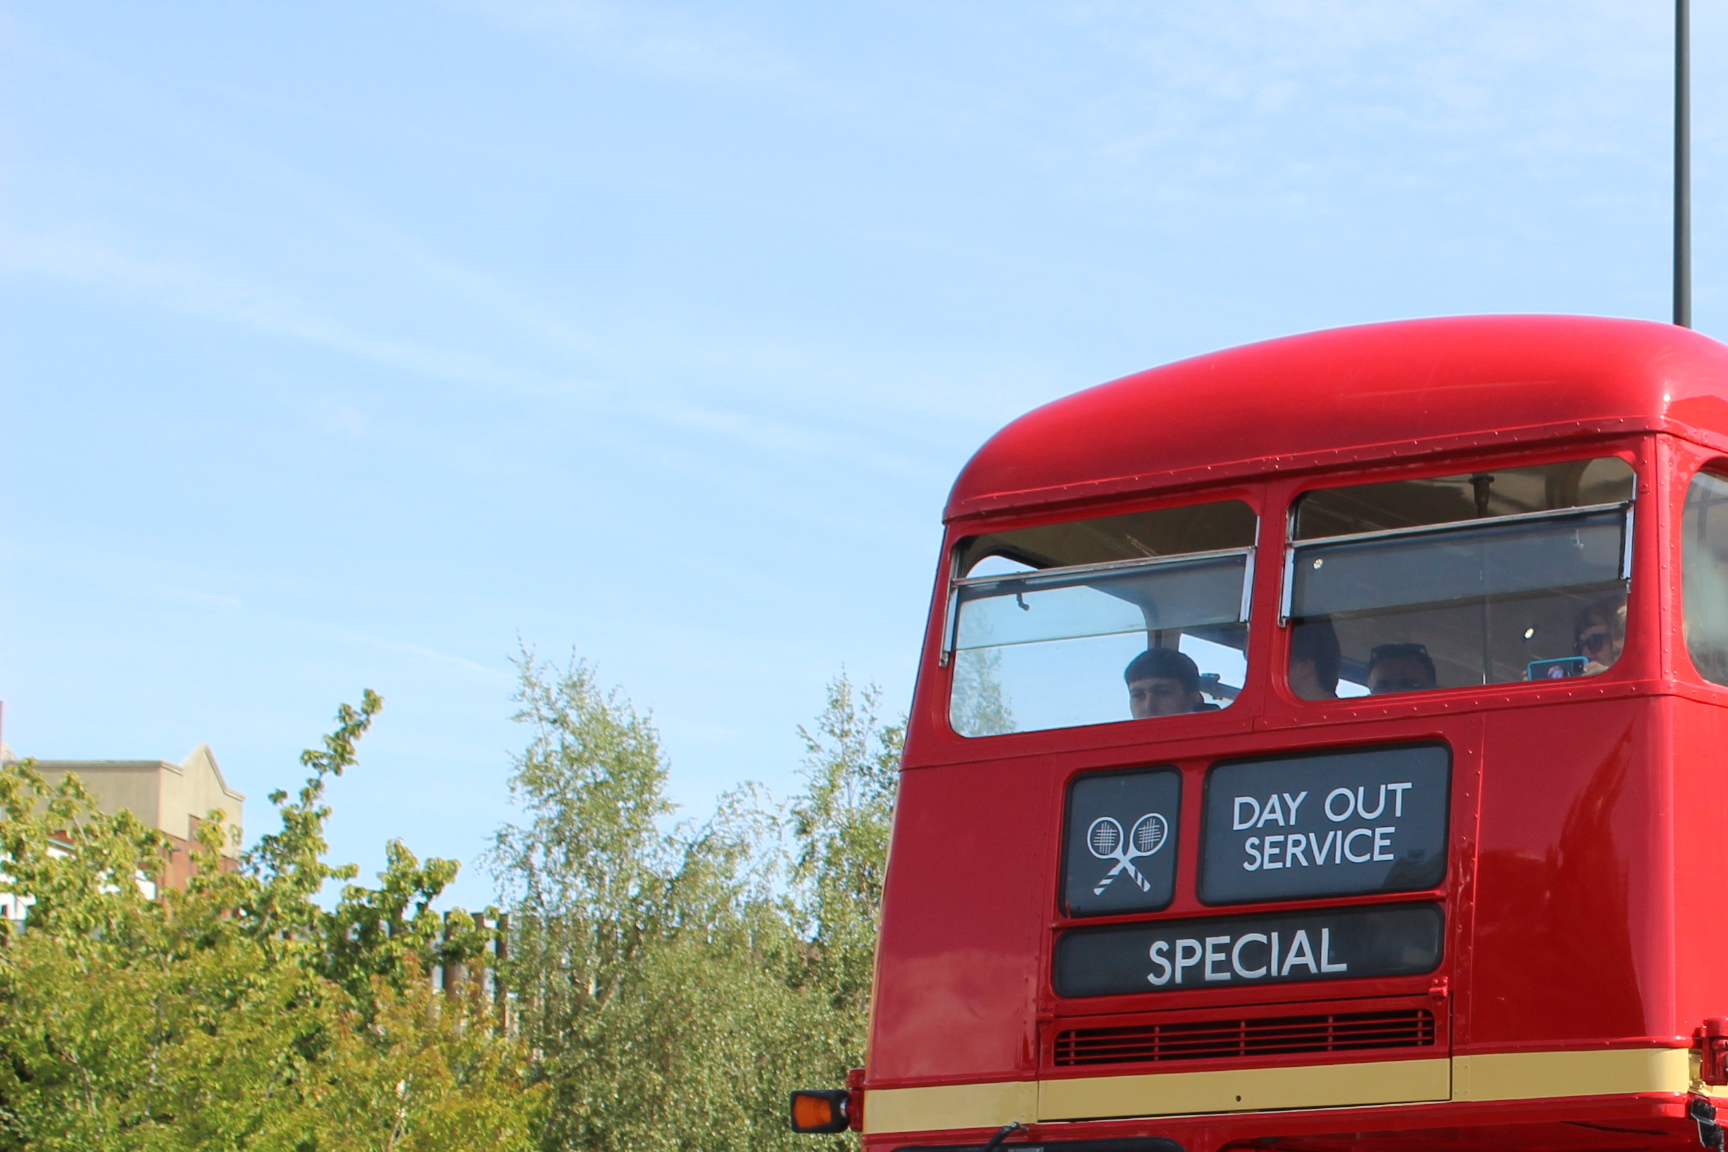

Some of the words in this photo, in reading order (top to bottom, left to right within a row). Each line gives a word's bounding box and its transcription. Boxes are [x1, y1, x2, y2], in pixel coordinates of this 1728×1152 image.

[1232, 791, 1308, 831] DAY
[1324, 782, 1412, 822] OUT
[1242, 826, 1396, 871] SERVICE
[1147, 928, 1347, 986] SPECIAL
